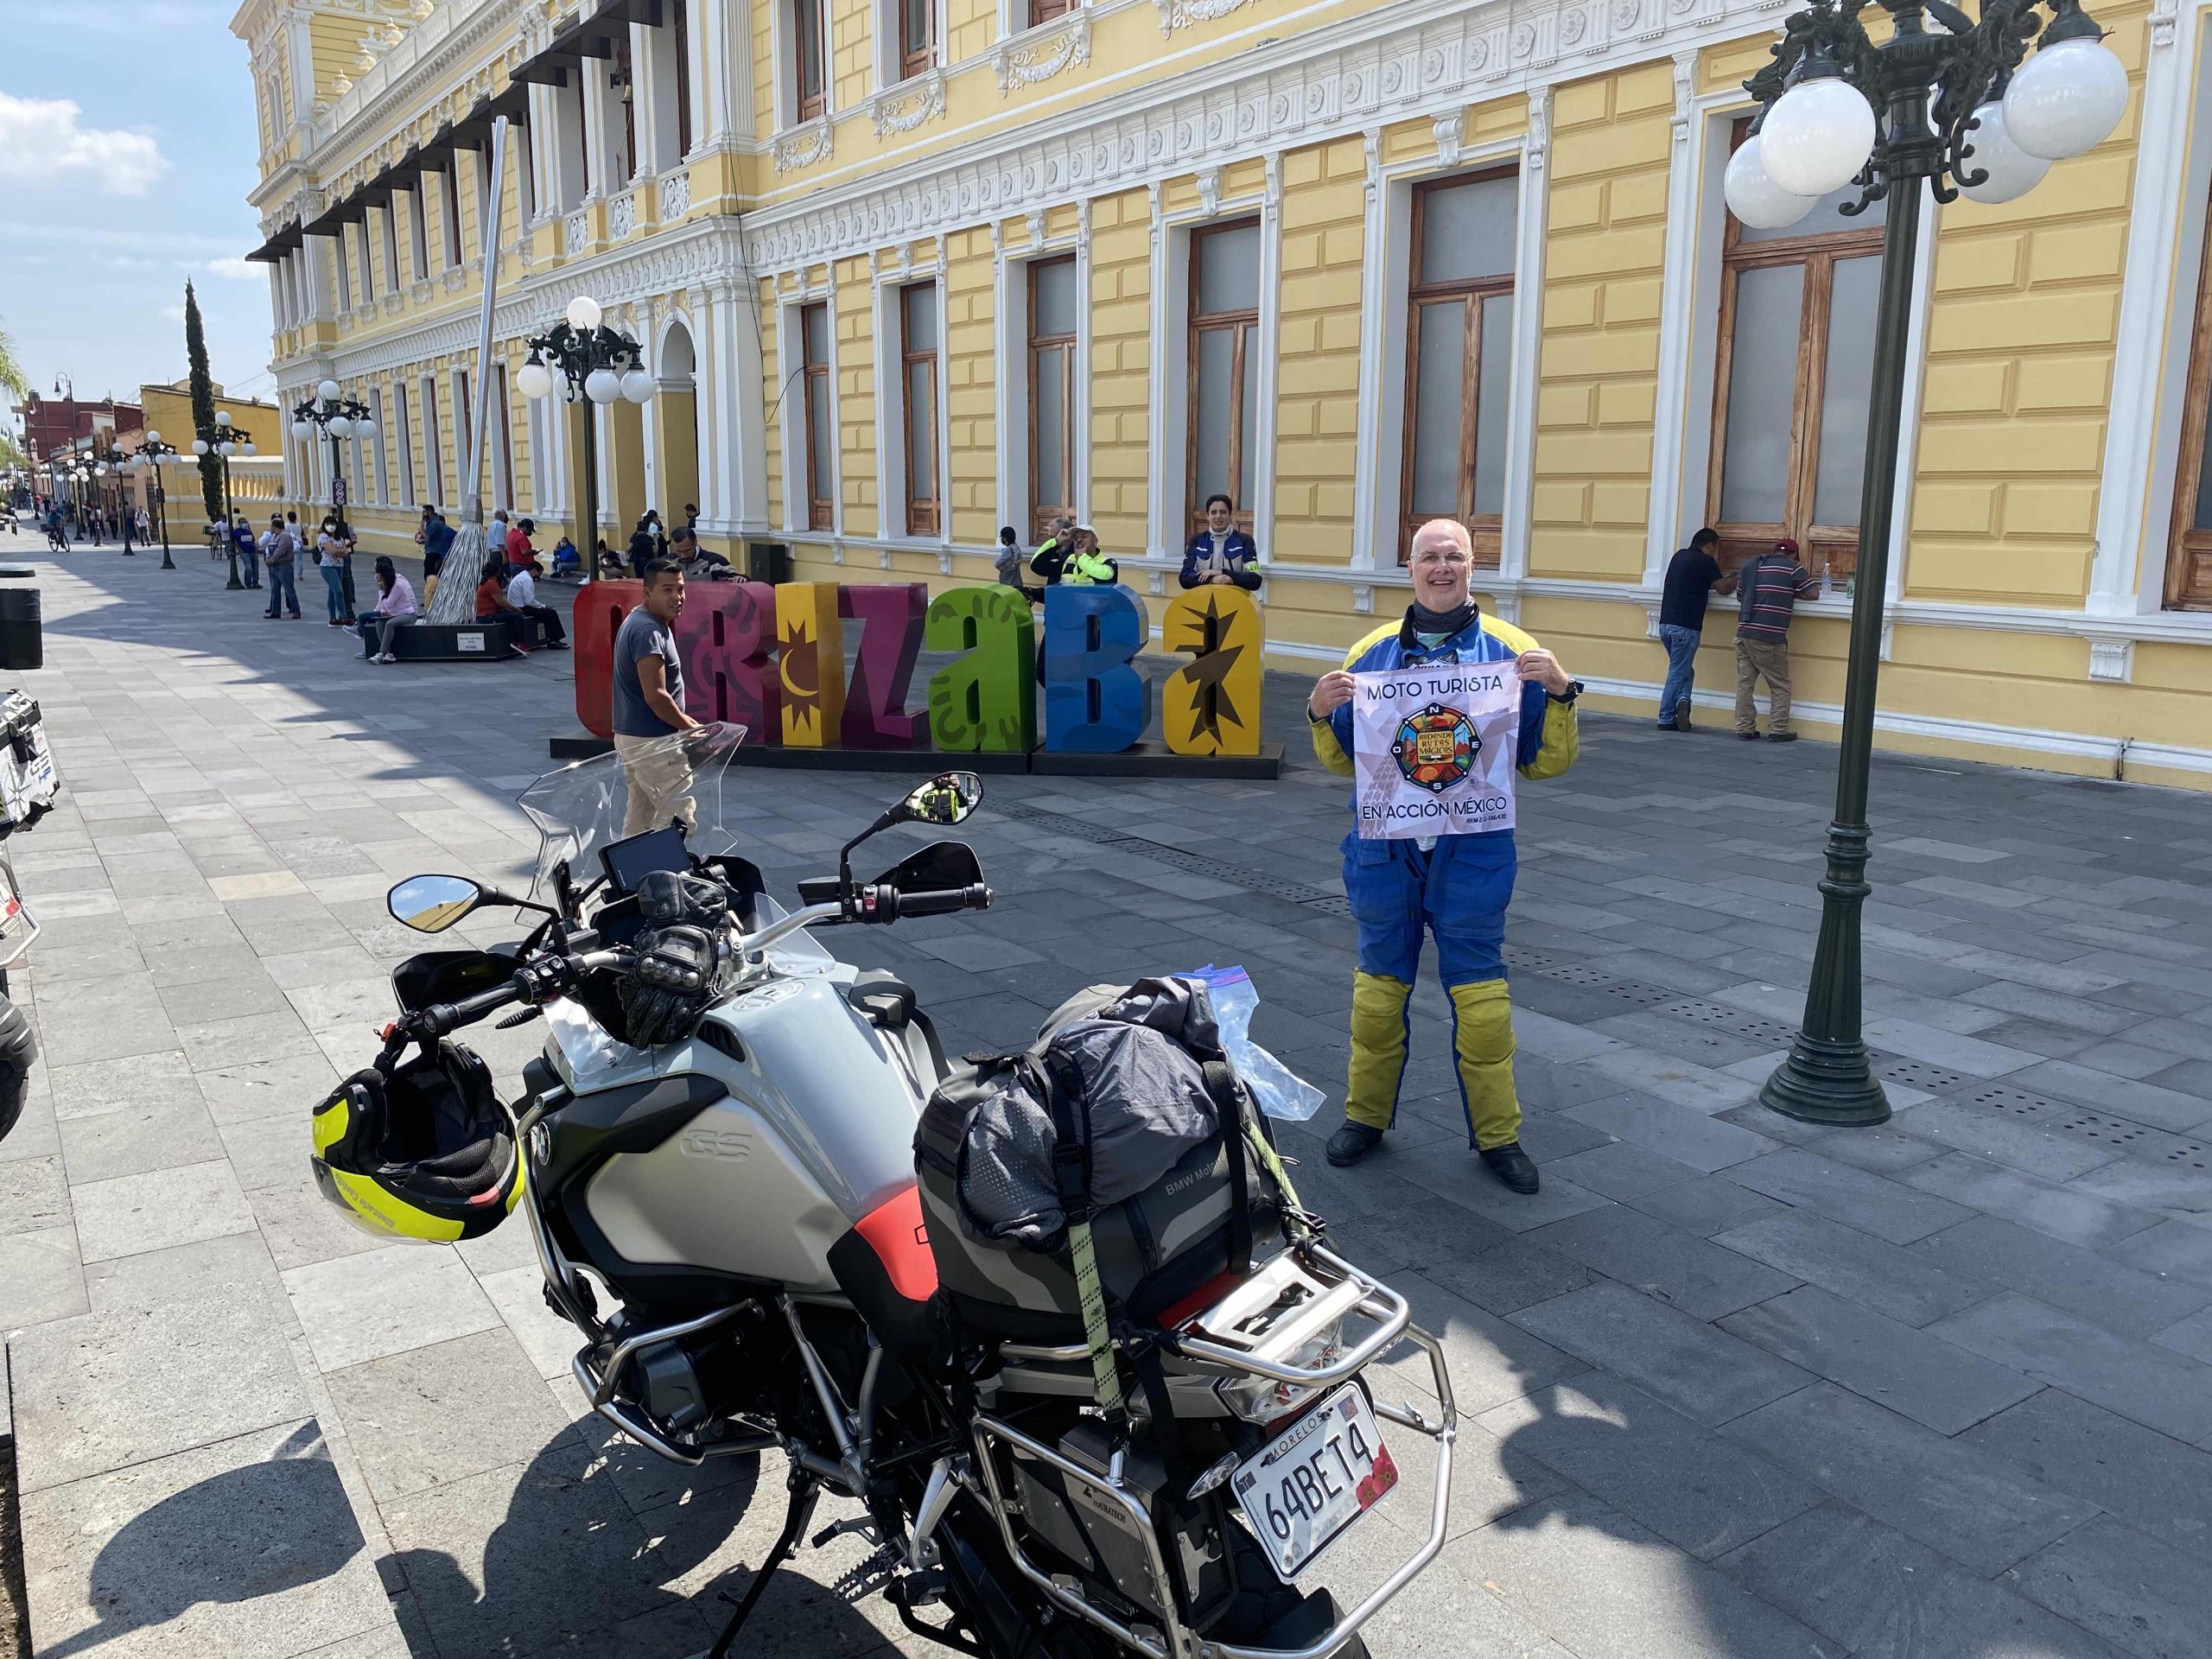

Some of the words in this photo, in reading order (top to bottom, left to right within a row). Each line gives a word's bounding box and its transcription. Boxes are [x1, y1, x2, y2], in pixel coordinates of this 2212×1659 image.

[1367, 682, 1422, 701] MOTO
[1427, 675, 1503, 695] TURISTA
[38, 766, 51, 785] HP
[1362, 805, 1382, 820] EN
[1386, 799, 1450, 819] ACCIÓN
[1454, 797, 1507, 815] MÉXICO
[680, 1129, 753, 1162] GS
[1166, 1173, 1193, 1196] BMW
[1265, 1421, 1374, 1541] 64BET4
[1093, 1499, 1126, 1523] TOURATECH
